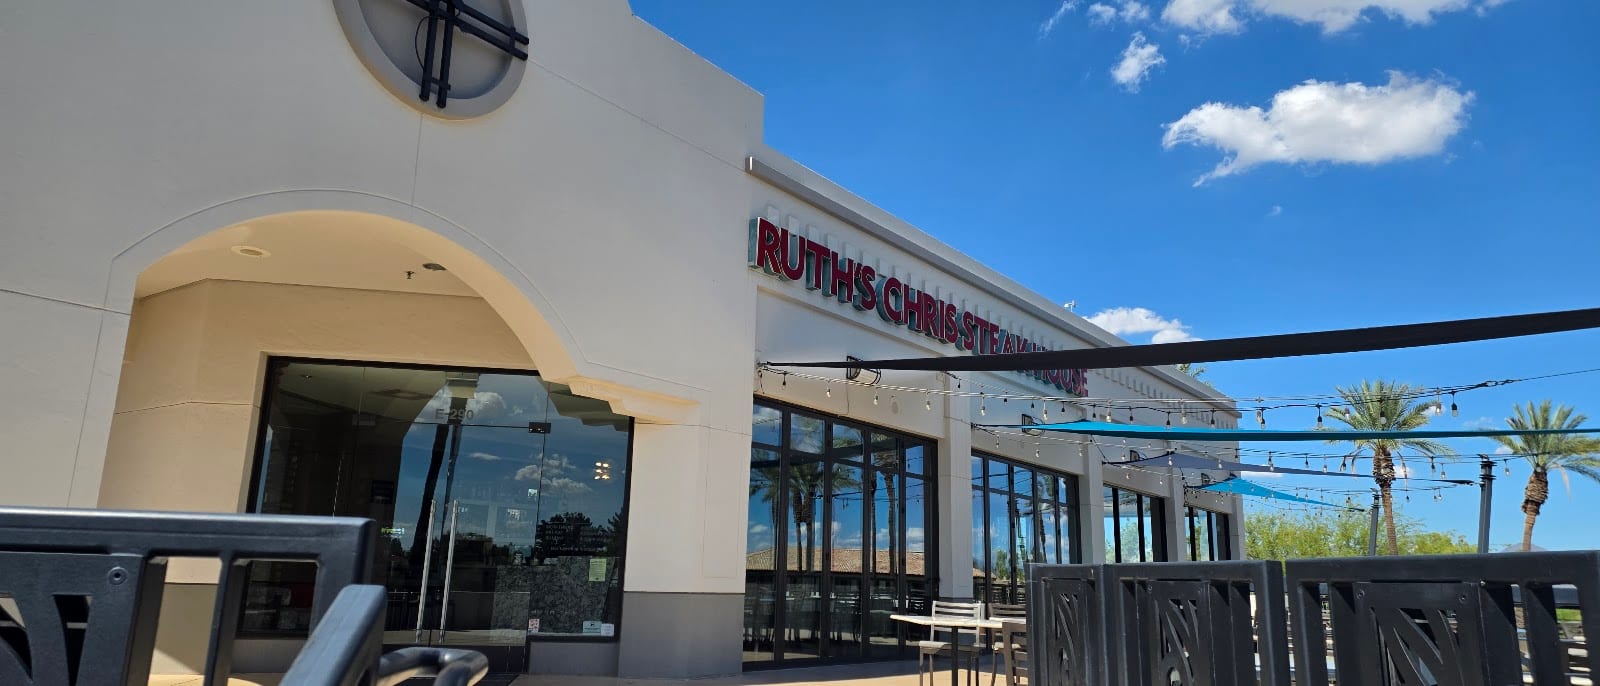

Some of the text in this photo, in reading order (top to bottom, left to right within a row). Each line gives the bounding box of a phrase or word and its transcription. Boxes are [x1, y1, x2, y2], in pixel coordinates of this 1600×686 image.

[756, 216, 877, 311] RUTH'S
[884, 277, 959, 344] CHRIS
[435, 408, 474, 421] E-290
